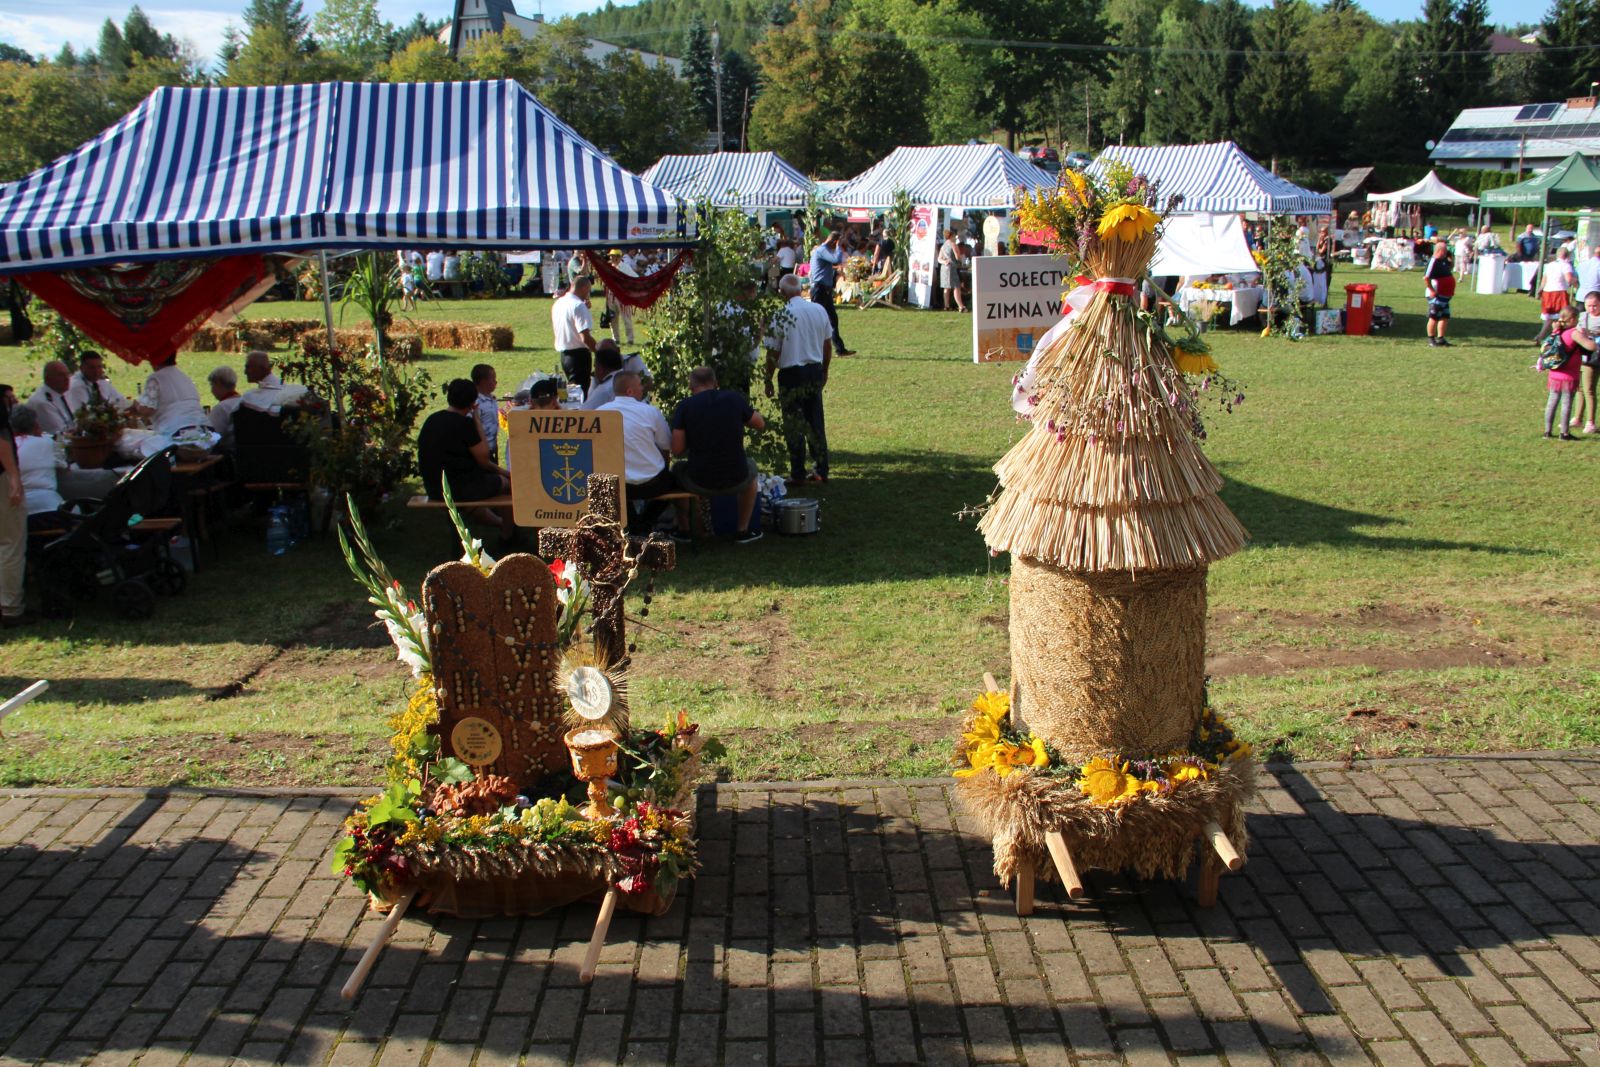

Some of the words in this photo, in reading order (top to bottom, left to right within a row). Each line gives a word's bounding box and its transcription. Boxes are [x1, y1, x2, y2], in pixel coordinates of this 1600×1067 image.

[986, 301, 1043, 319] ZIMNA
[528, 416, 602, 434] NIEPLA
[534, 509, 573, 520] Gmina
[504, 586, 542, 612] IV
[513, 615, 536, 639] V
